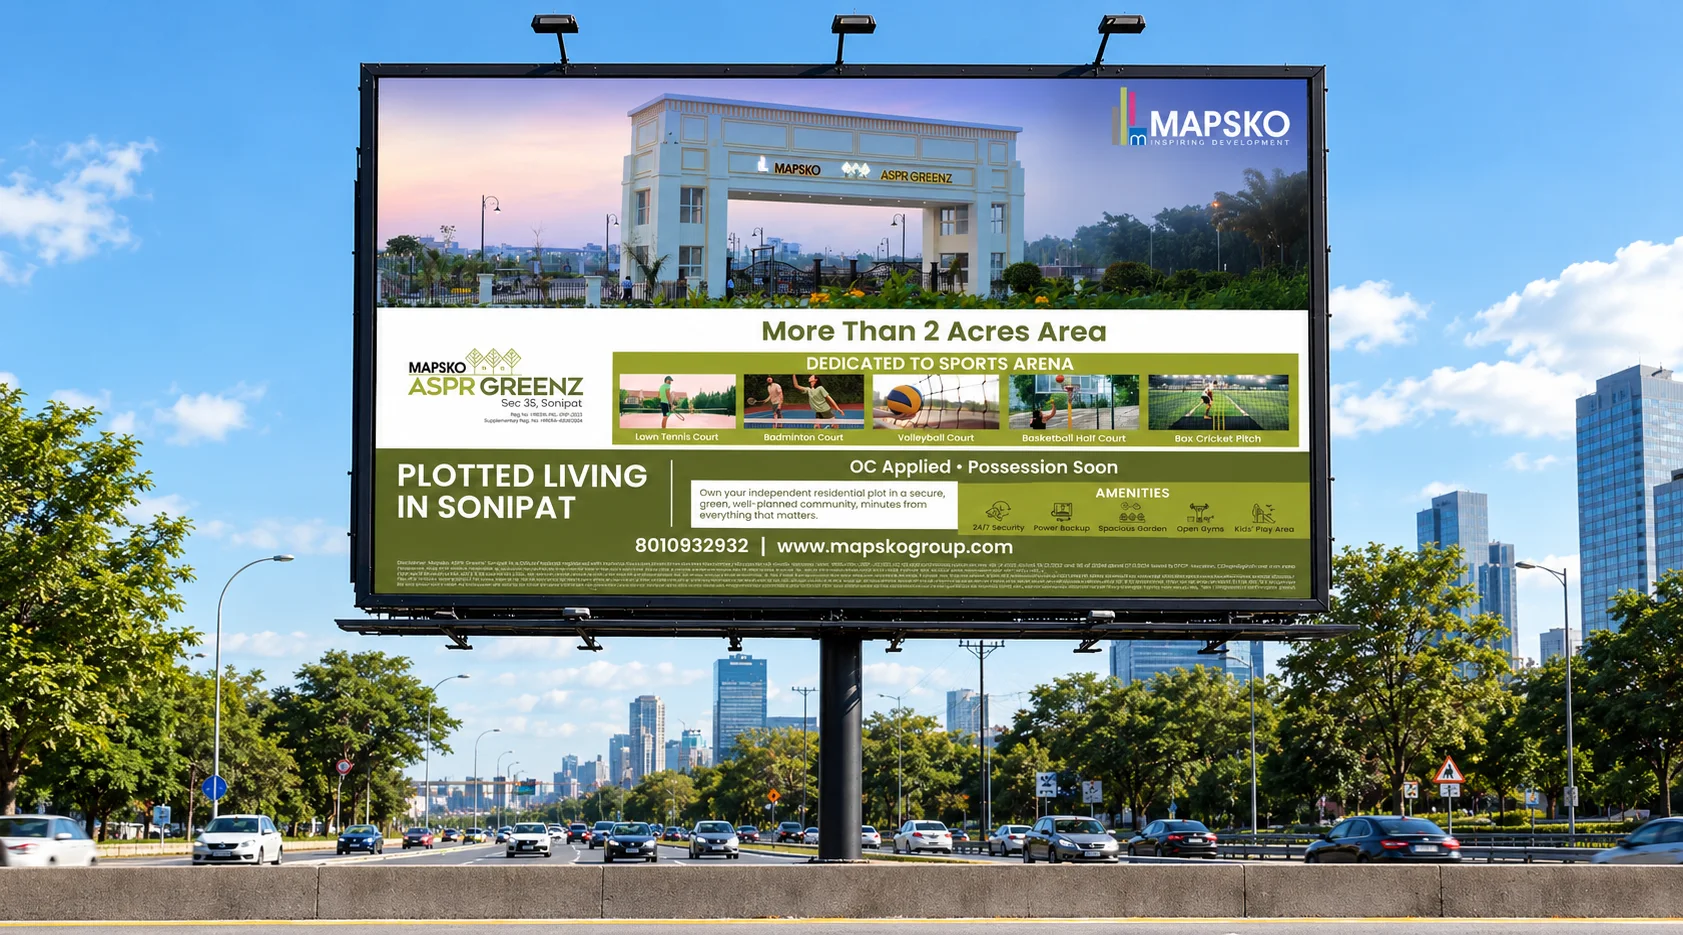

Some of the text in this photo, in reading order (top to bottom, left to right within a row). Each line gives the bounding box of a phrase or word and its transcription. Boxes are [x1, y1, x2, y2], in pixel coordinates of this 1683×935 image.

[1150, 110, 1290, 138] MAPSKO
[774, 163, 821, 176] MAPSKO
[880, 170, 953, 184] ASPR GREENZ
[762, 320, 1106, 342] More Than 2 Acres Area
[409, 362, 466, 373] MAPSKO
[807, 356, 1074, 371] DEDICATED TO SPORTS ARENA
[408, 377, 584, 396] ASPR GREENZ
[502, 398, 582, 409] Sec 35, Sonipat
[635, 433, 719, 441] Lawn Tennis Court
[764, 433, 844, 442] Badminton Court
[898, 434, 974, 444] Volleyball Court
[1022, 434, 1126, 443] Basketball Half Court
[1175, 434, 1261, 443] Box Cricket Pitch
[850, 459, 1118, 478] OC Applied Possession Soon
[398, 464, 647, 488] PLOTTED LIVING
[699, 489, 946, 499] Own your independent residential plot in a secure,
[1096, 488, 1170, 498] AMENITIES
[398, 495, 576, 519] IN SONIPAT
[699, 500, 927, 511] green, well-planned community, minutes from
[699, 511, 818, 521] everything that matters.
[992, 524, 1025, 532] Security
[1060, 525, 1090, 533] Backup
[1098, 525, 1135, 533] Spacious
[1255, 526, 1272, 534] Play
[635, 537, 1013, 558] 8010932932 www.mapskogroup.com
